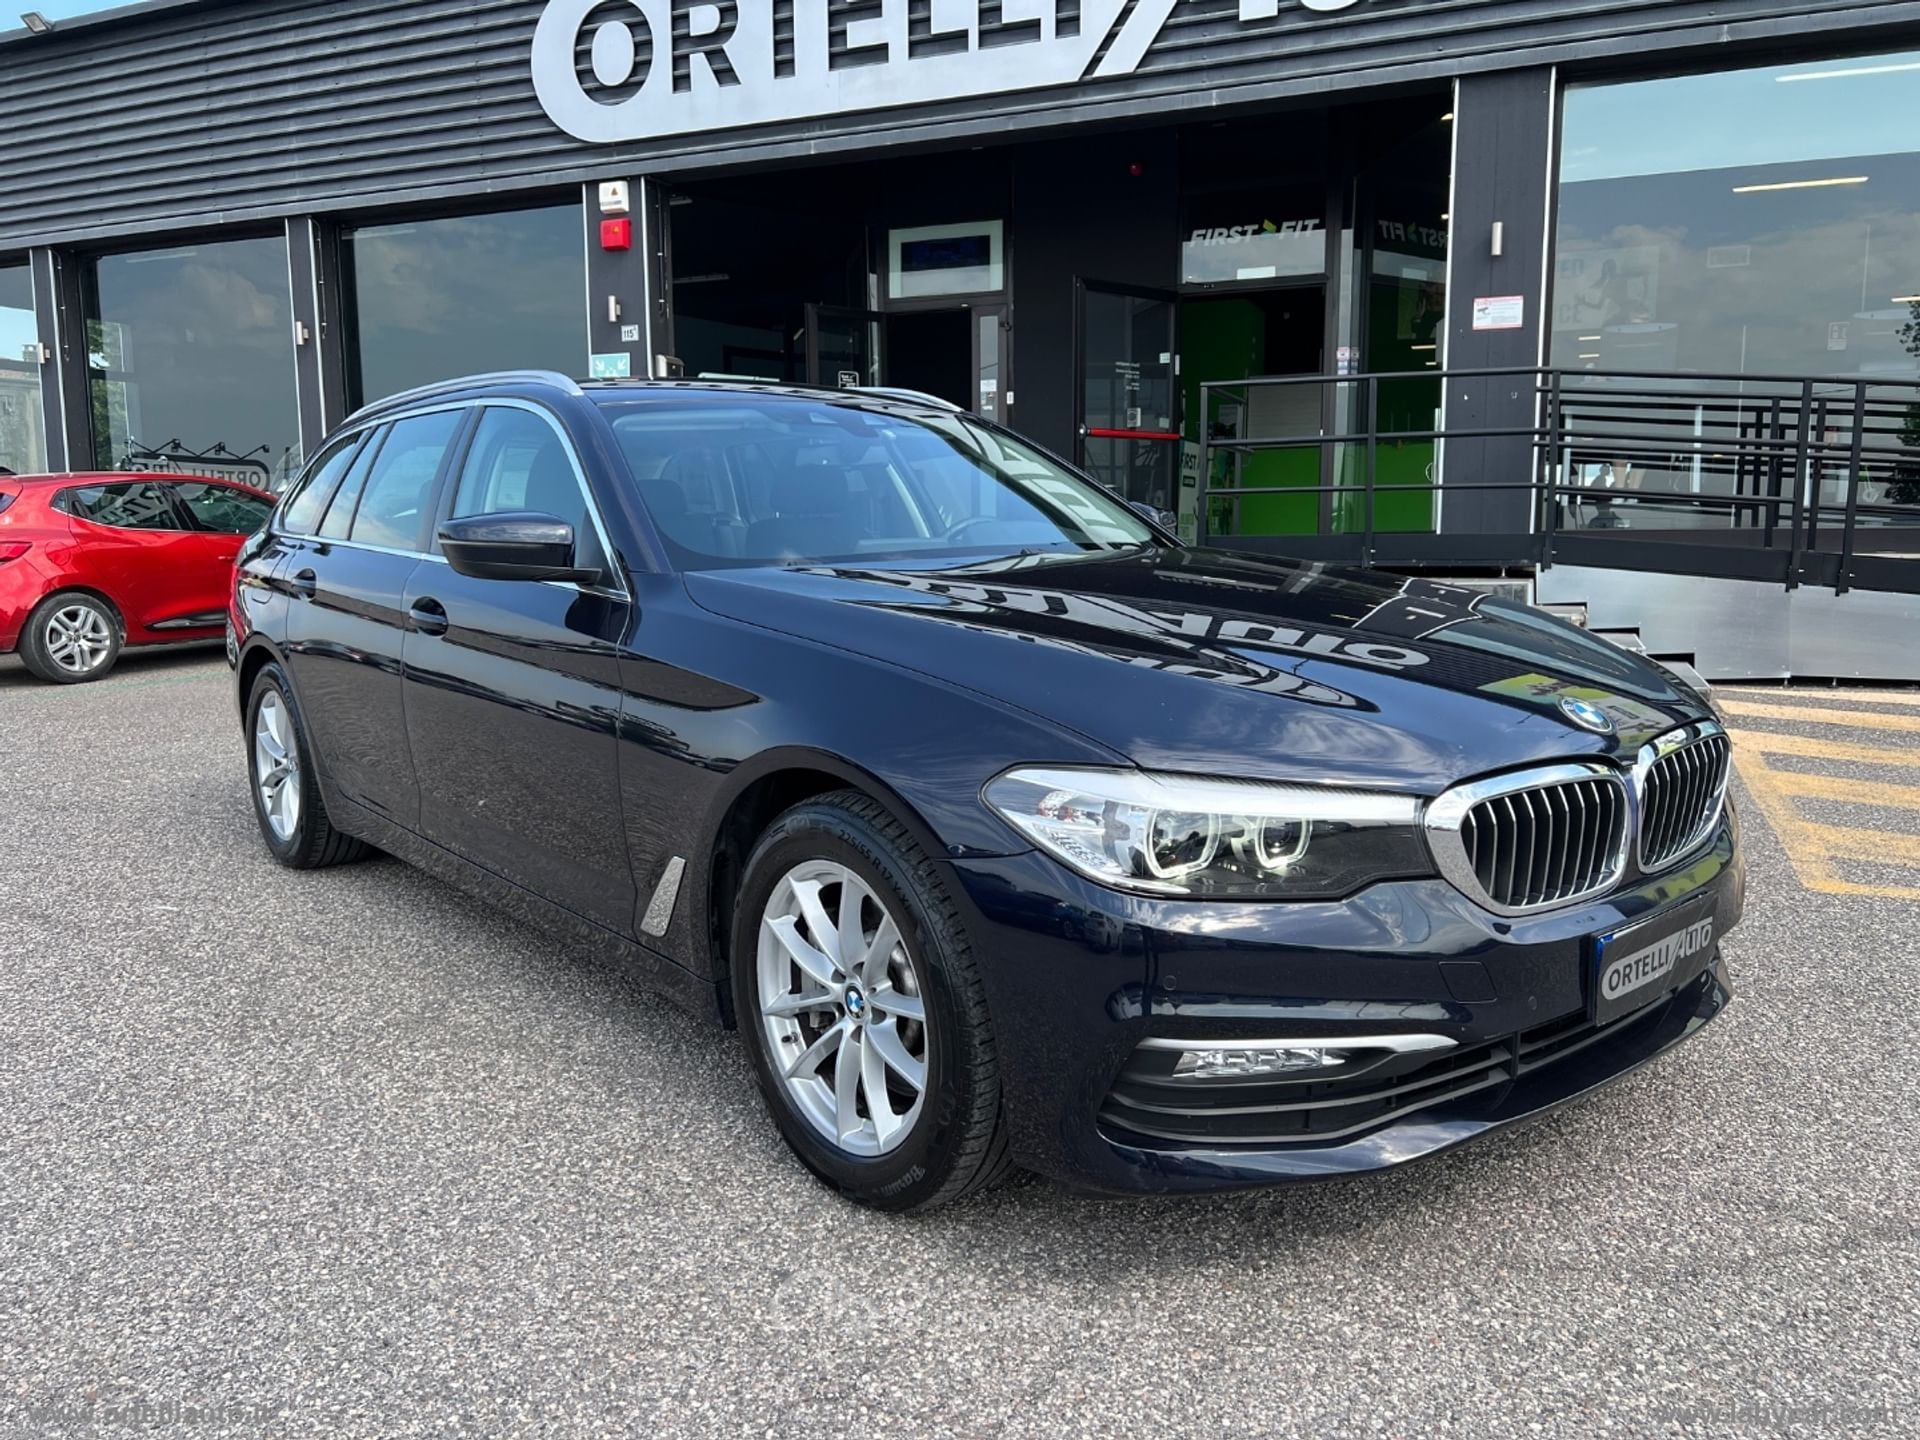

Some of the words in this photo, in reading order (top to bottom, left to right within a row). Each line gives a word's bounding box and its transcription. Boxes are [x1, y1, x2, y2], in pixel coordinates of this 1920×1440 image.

[1189, 224, 1260, 248] FIRST
[1278, 218, 1320, 241] FIT
[1608, 943, 1671, 992] ORTELLI
